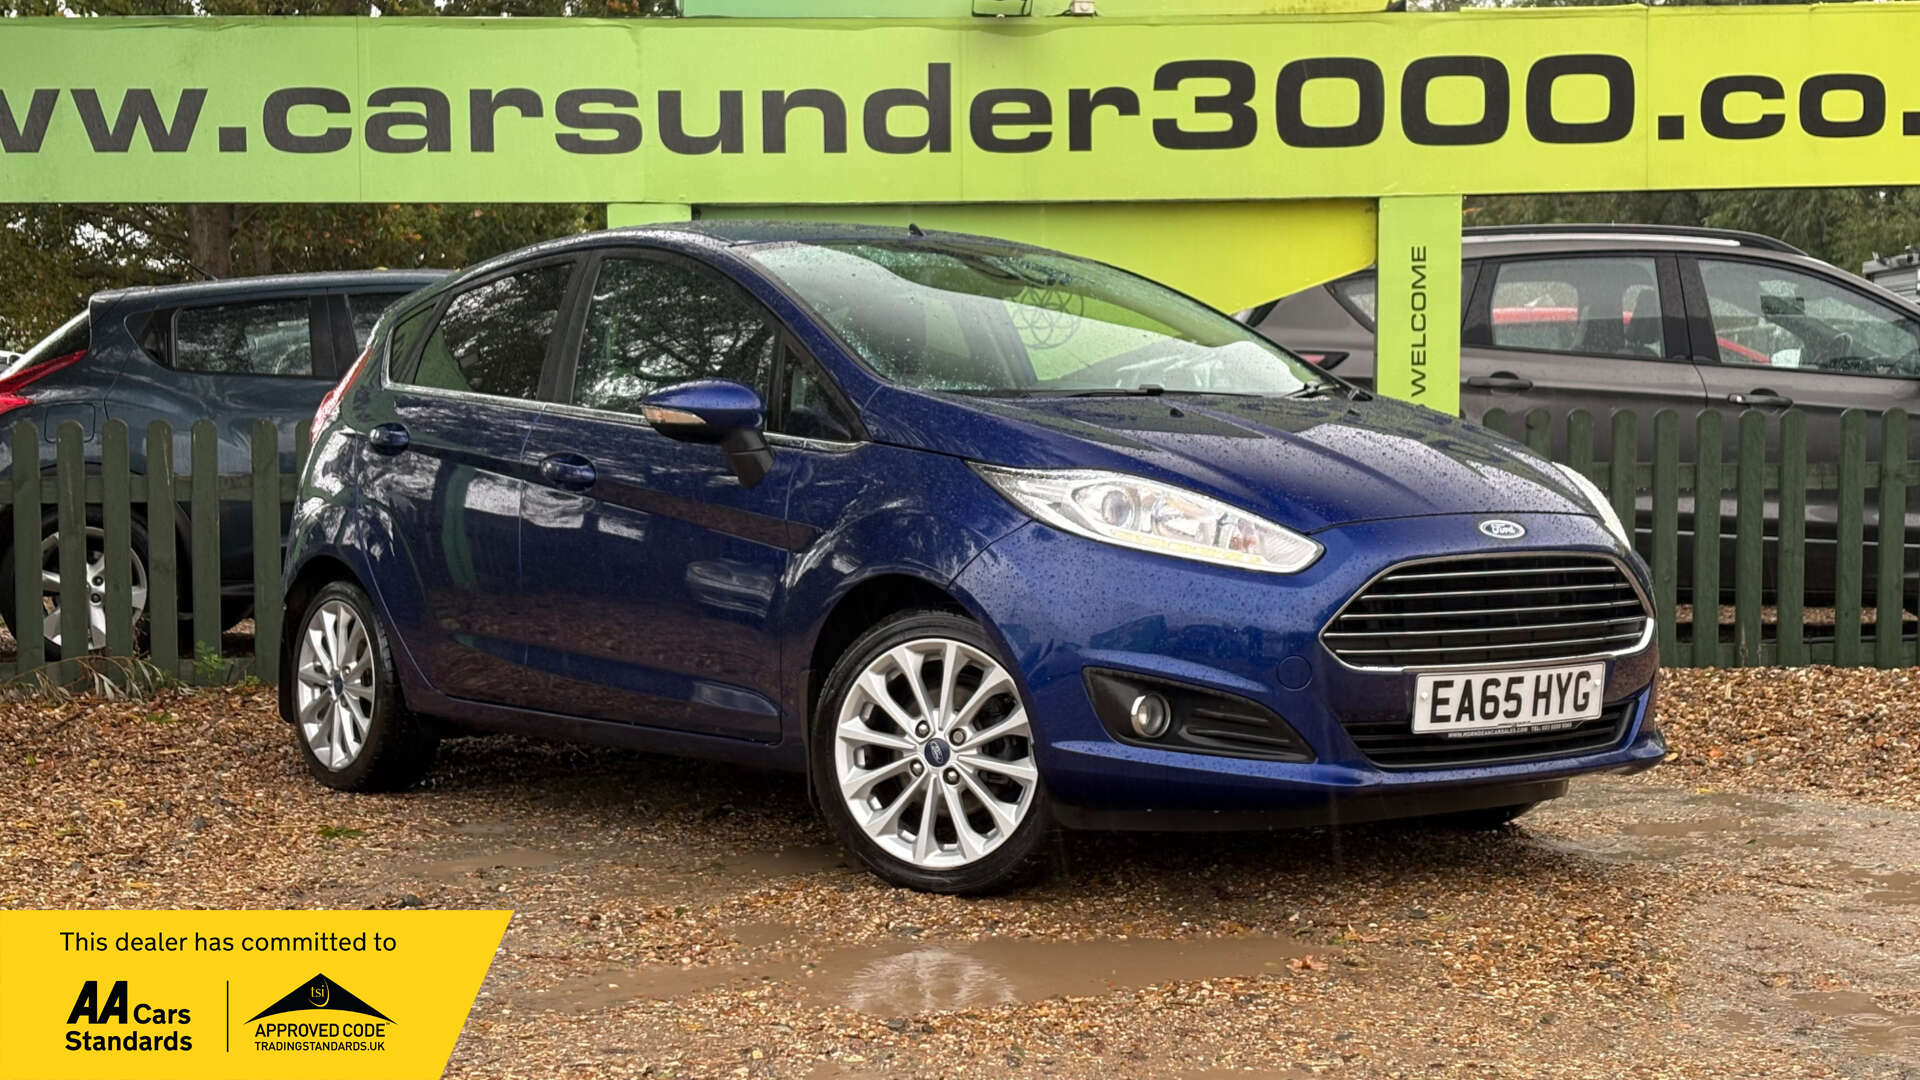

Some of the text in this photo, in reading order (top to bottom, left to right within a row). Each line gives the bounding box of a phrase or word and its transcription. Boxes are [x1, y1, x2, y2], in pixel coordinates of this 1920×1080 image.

[1411, 246, 1427, 397] WELCOME
[1430, 670, 1591, 724] EA65 HYG
